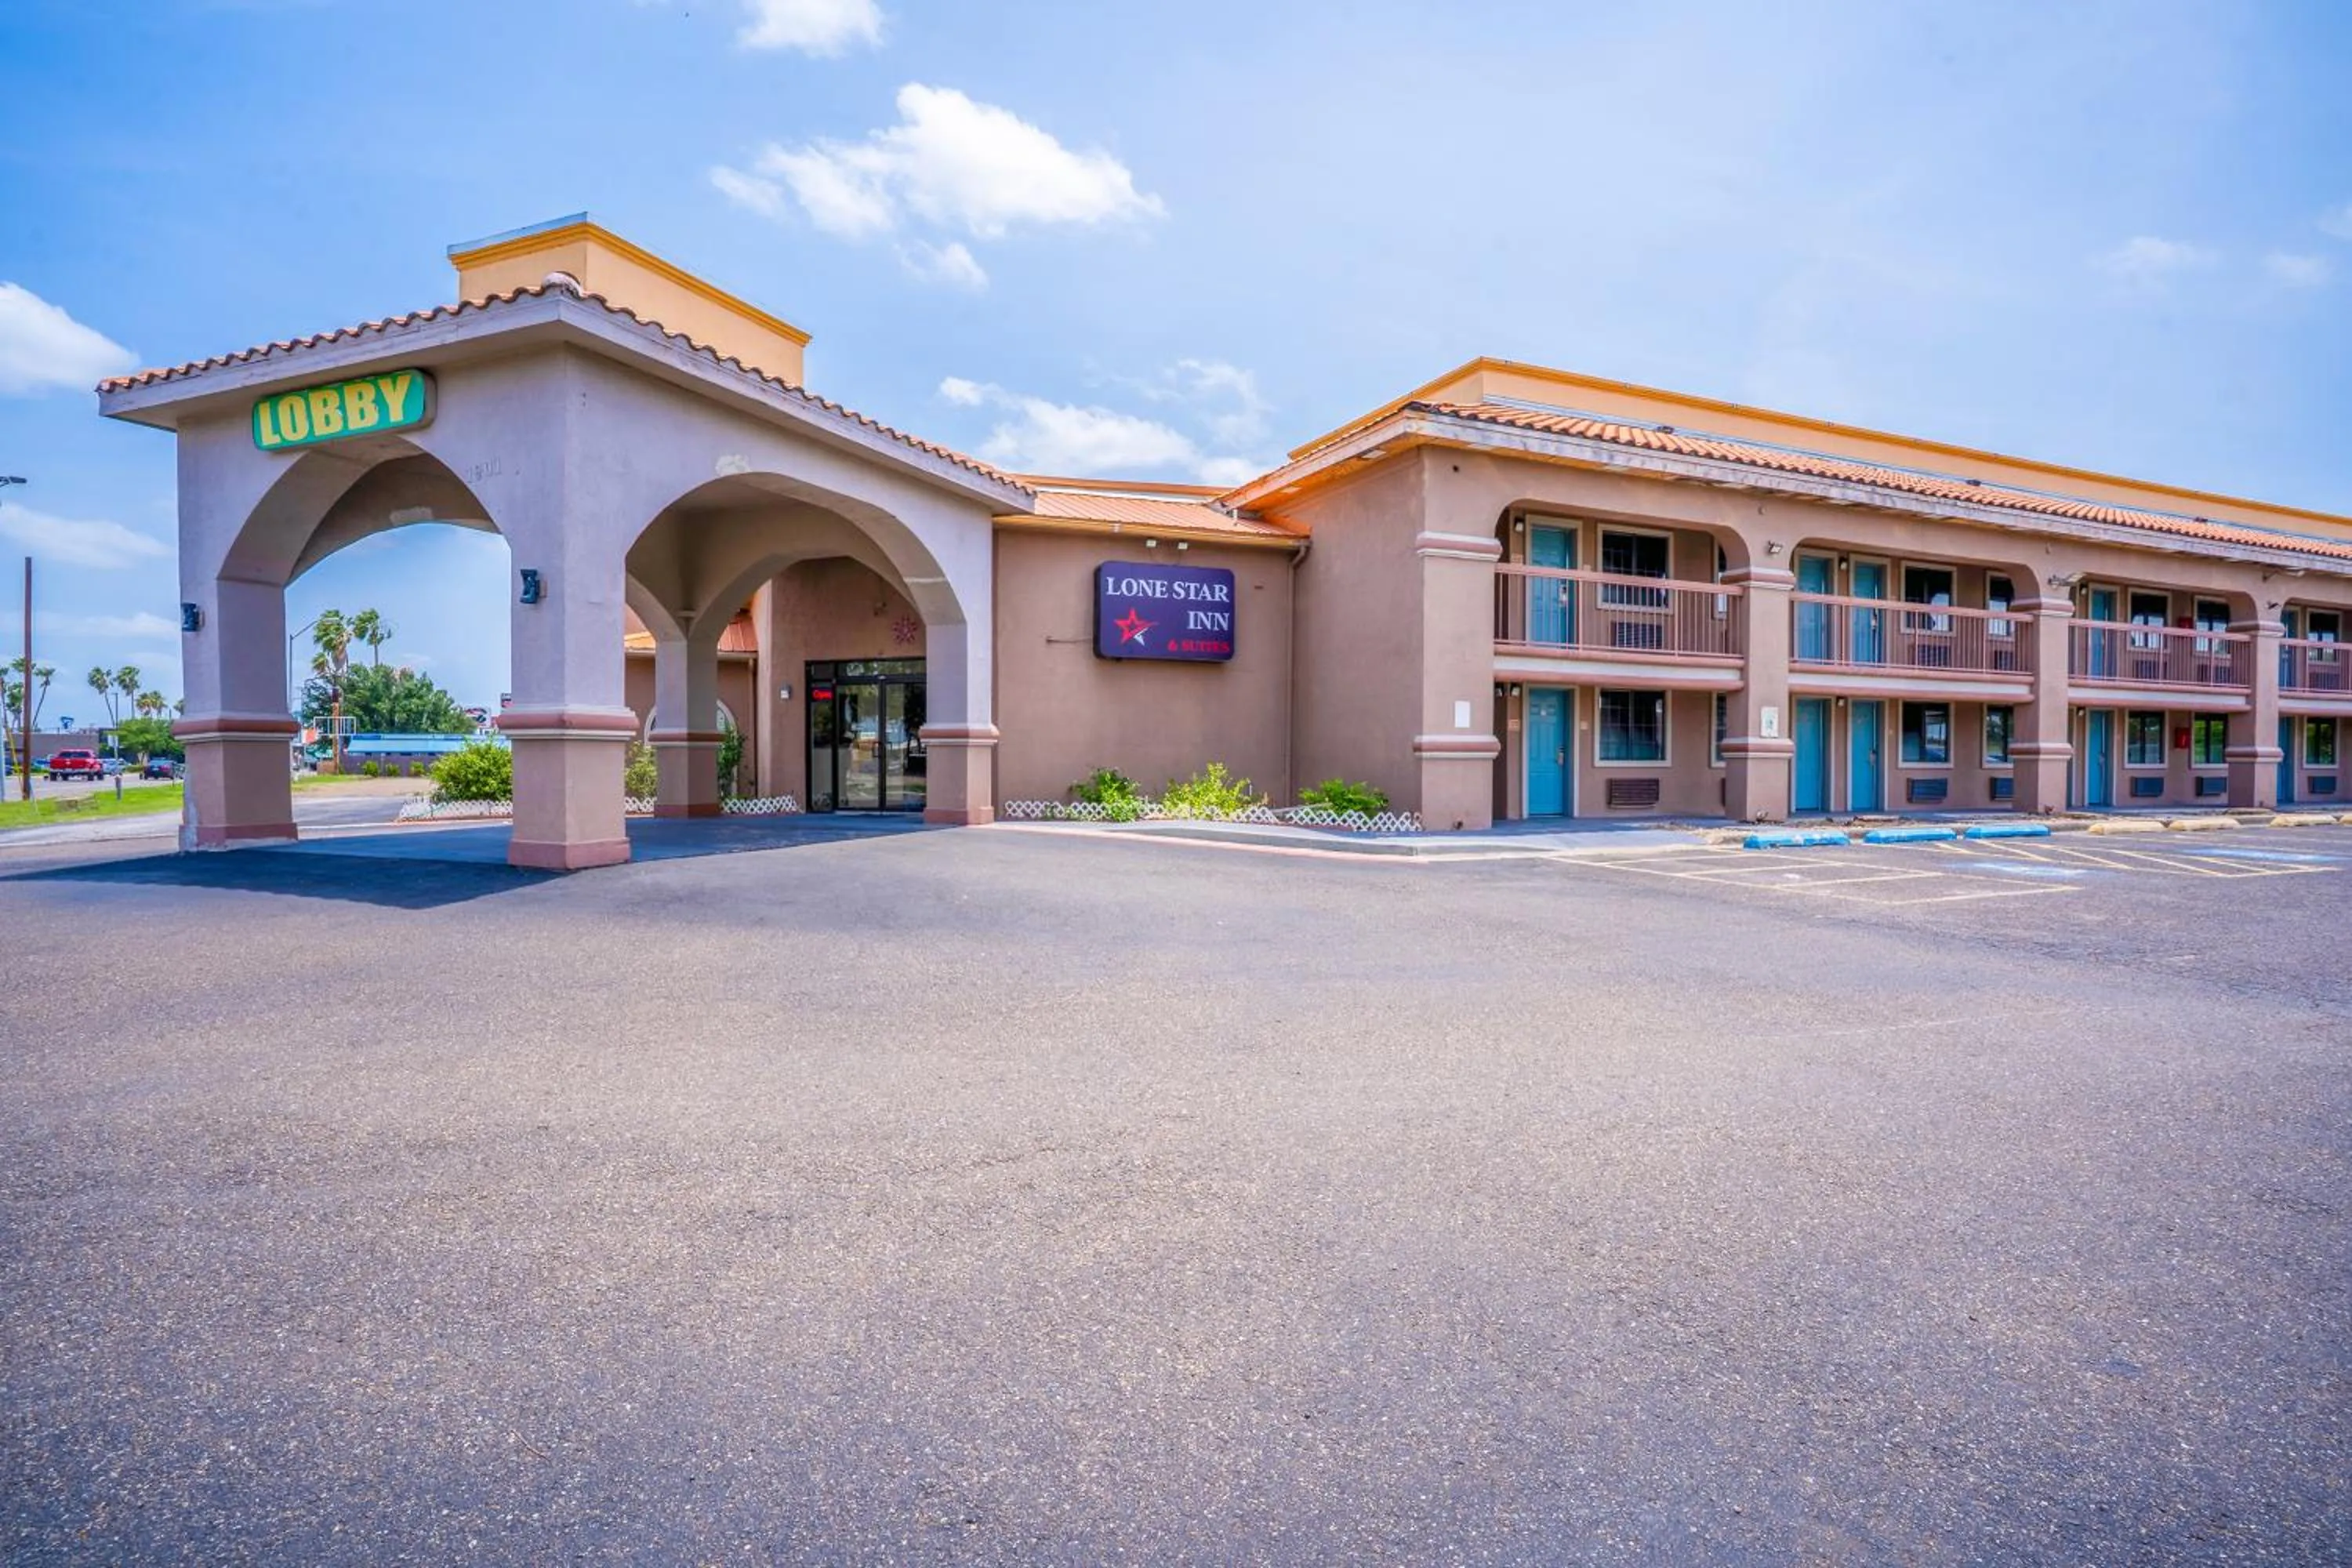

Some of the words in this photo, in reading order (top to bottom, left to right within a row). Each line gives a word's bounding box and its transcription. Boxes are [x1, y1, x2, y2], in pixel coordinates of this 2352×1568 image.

[259, 375, 412, 445] LOBBY
[1106, 576, 1168, 598] LONE
[1172, 581, 1229, 602] STAR
[1187, 611, 1229, 631] INN
